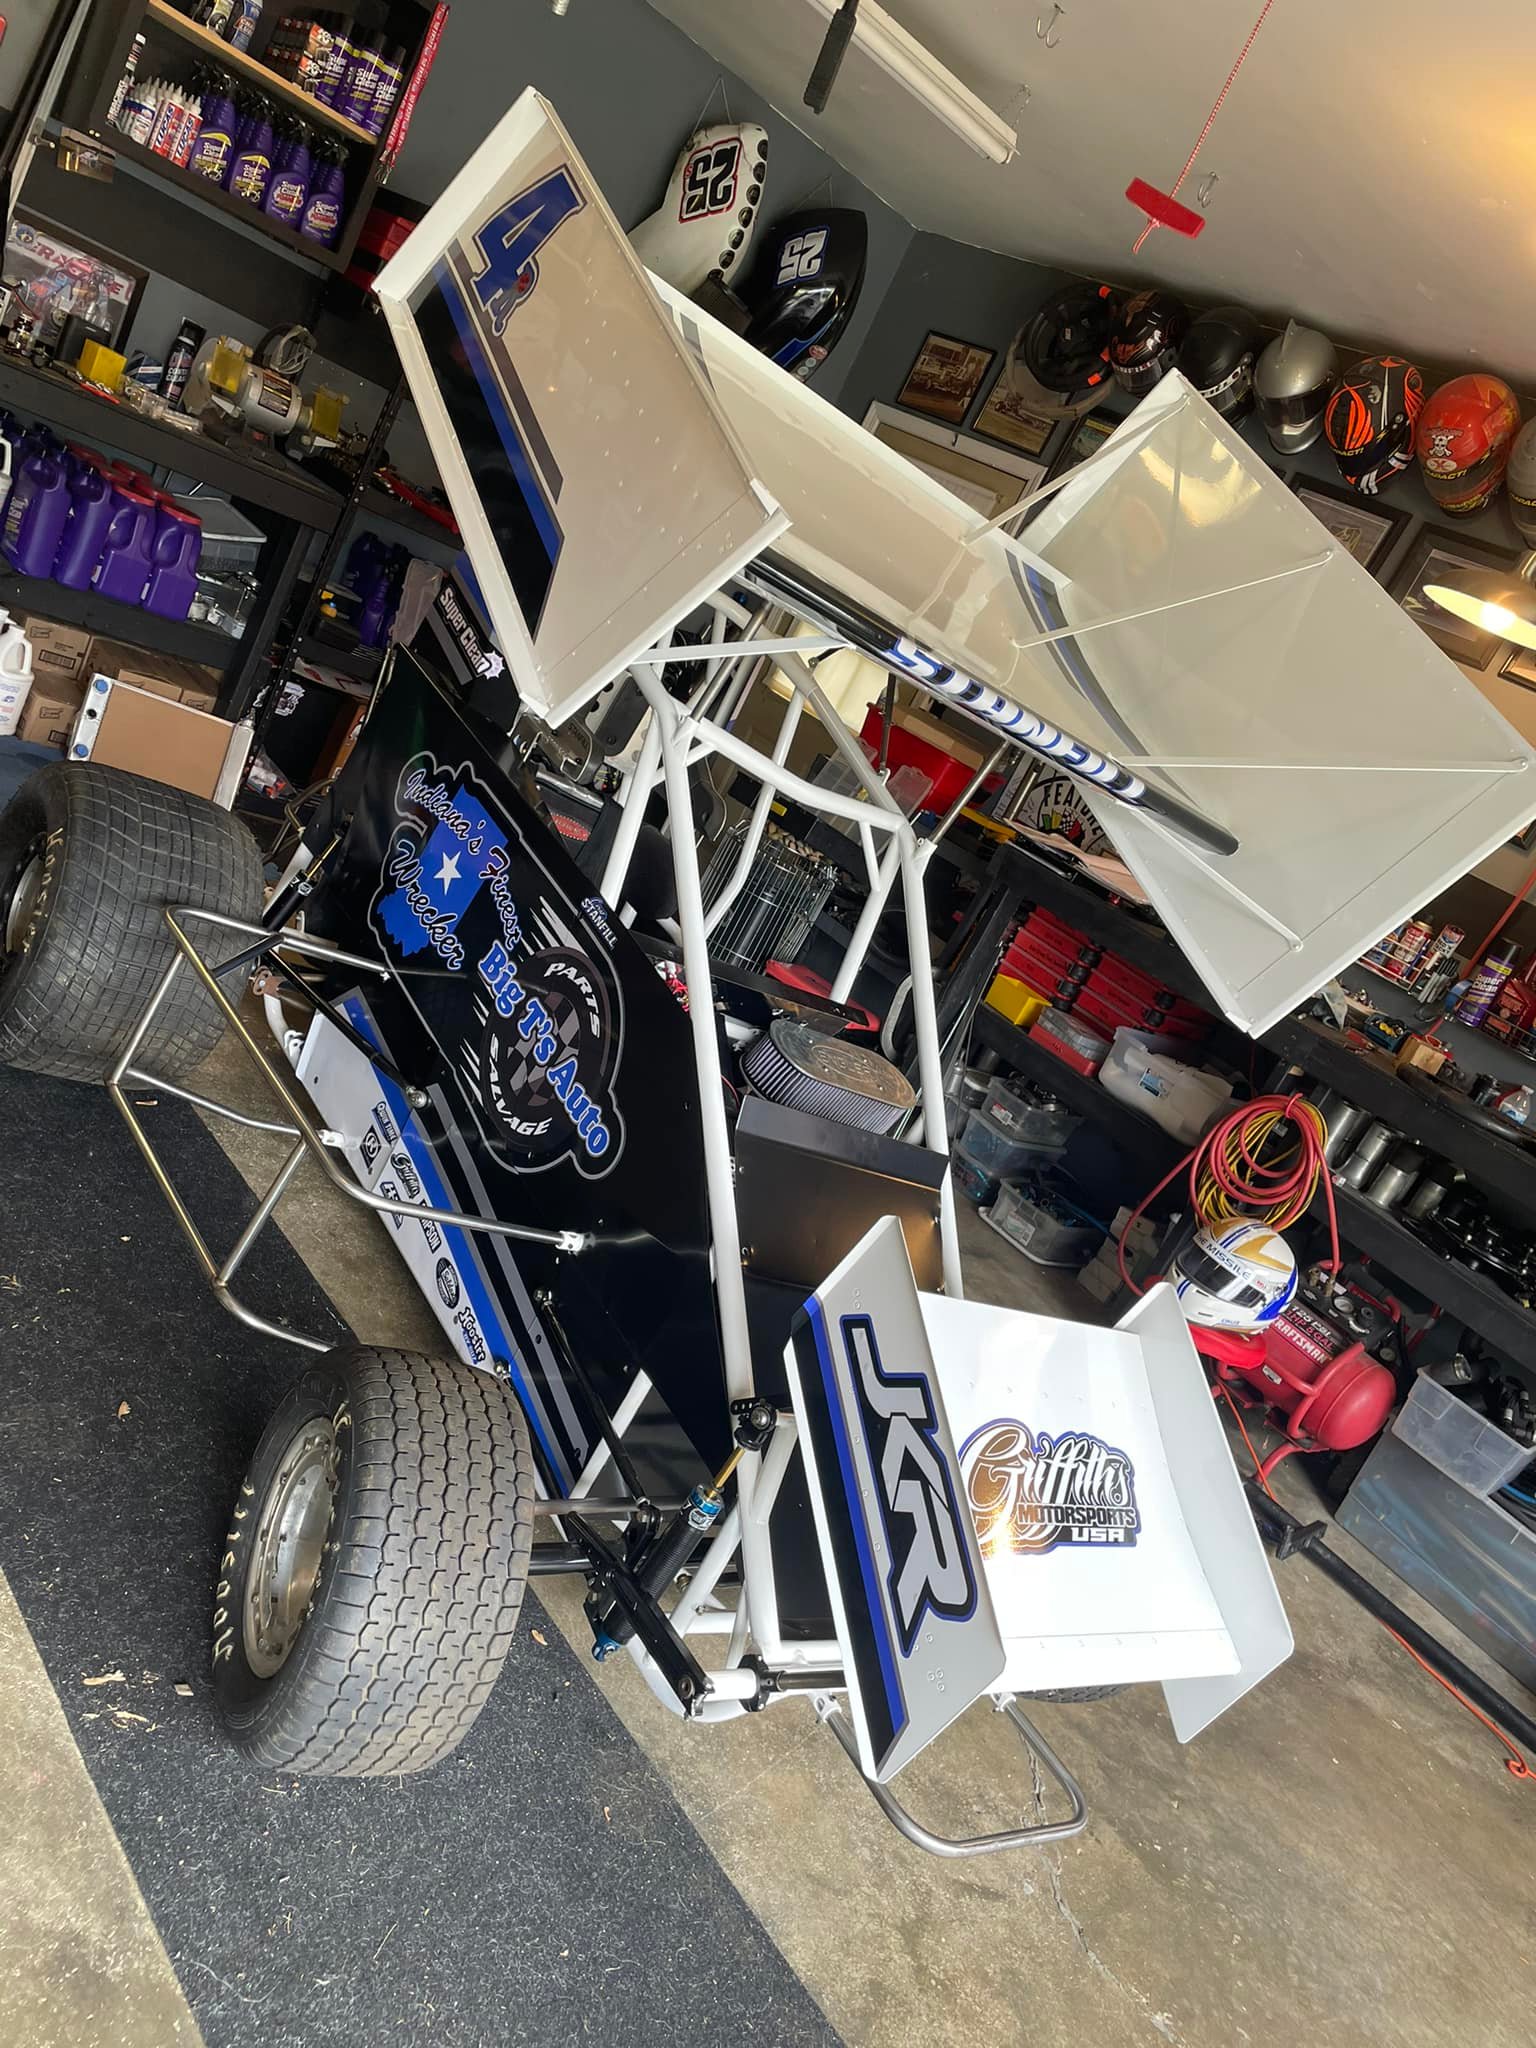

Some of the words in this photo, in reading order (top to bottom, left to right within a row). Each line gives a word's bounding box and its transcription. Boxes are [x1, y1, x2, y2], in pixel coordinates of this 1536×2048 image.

[440, 587, 467, 631] Super
[460, 626, 490, 674] Clean
[404, 769, 486, 854] Indiana's
[390, 840, 465, 970] Wrecker
[479, 846, 522, 951] Finest
[580, 897, 619, 947] STANFILL
[544, 962, 601, 1039] PARTS
[1473, 980, 1497, 993] Clean
[1476, 973, 1503, 987] Super
[478, 940, 525, 1017] Big
[517, 998, 557, 1065] T's
[546, 1056, 609, 1156] Auto
[489, 1033, 552, 1136] SALVAGE
[1206, 1244, 1252, 1280] MISSILE
[1274, 1318, 1327, 1364] RAFTSMAN
[846, 1320, 974, 1650] JKR
[959, 1422, 1131, 1540] Griffiths
[1017, 1502, 1136, 1529] MOTORSPORTS
[1071, 1527, 1126, 1543] USA
